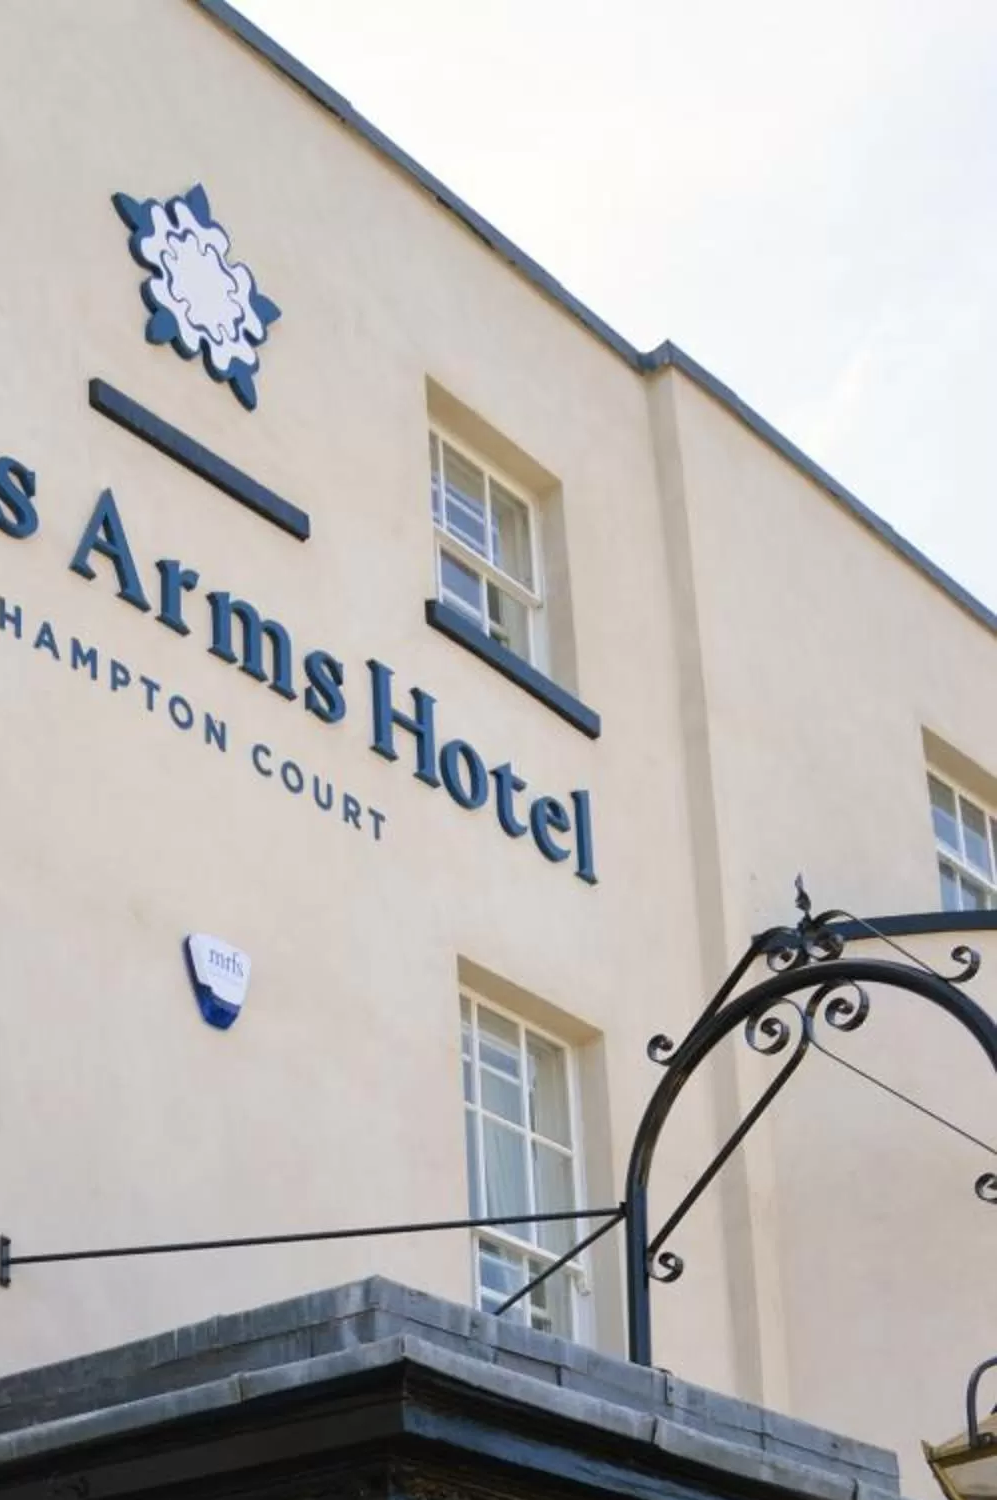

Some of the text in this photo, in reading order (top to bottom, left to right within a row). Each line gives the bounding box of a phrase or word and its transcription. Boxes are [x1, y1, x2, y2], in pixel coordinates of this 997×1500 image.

[68, 487, 347, 725] Arms
[364, 658, 599, 886] Hotel
[251, 742, 387, 841] COURT
